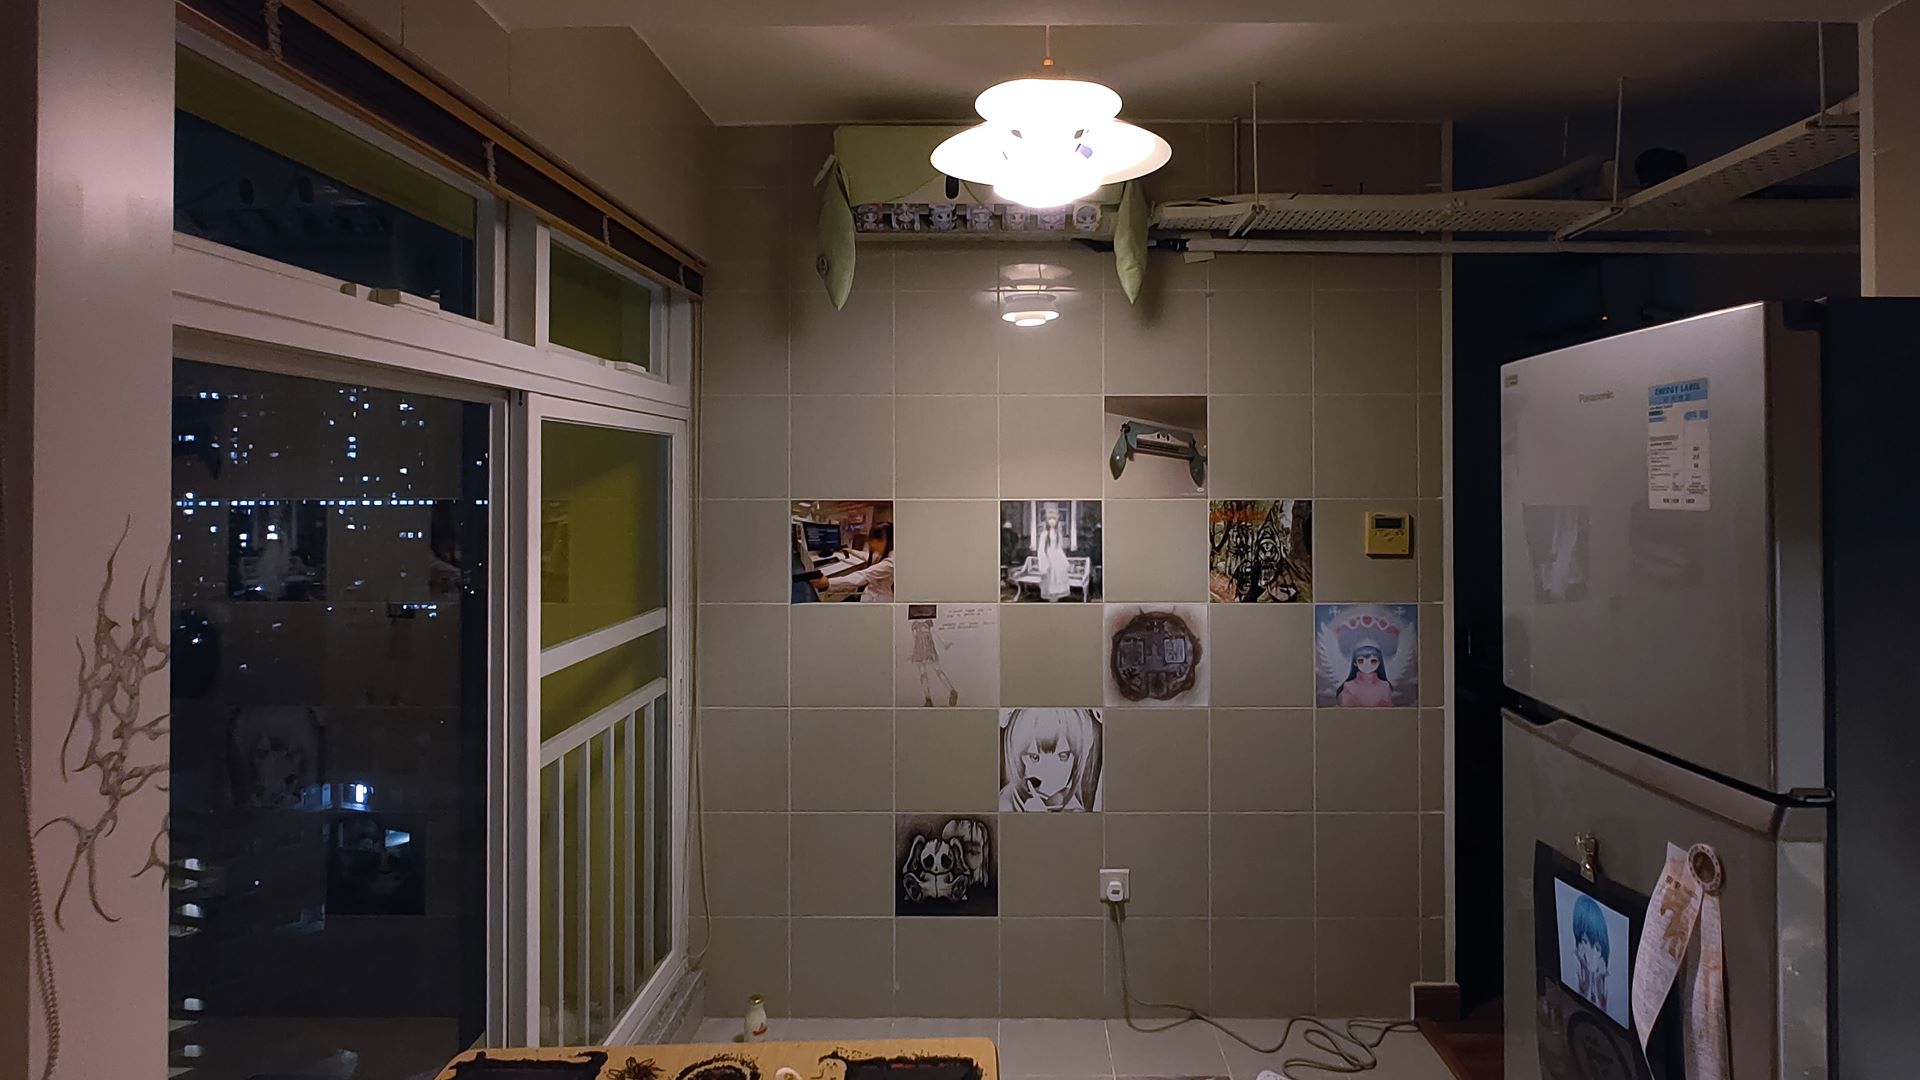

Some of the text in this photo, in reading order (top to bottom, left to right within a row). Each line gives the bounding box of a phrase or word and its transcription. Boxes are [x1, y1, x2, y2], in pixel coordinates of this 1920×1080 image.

[1654, 382, 1700, 396] ENERGY LABEL
[1578, 391, 1614, 403] Panasonic
